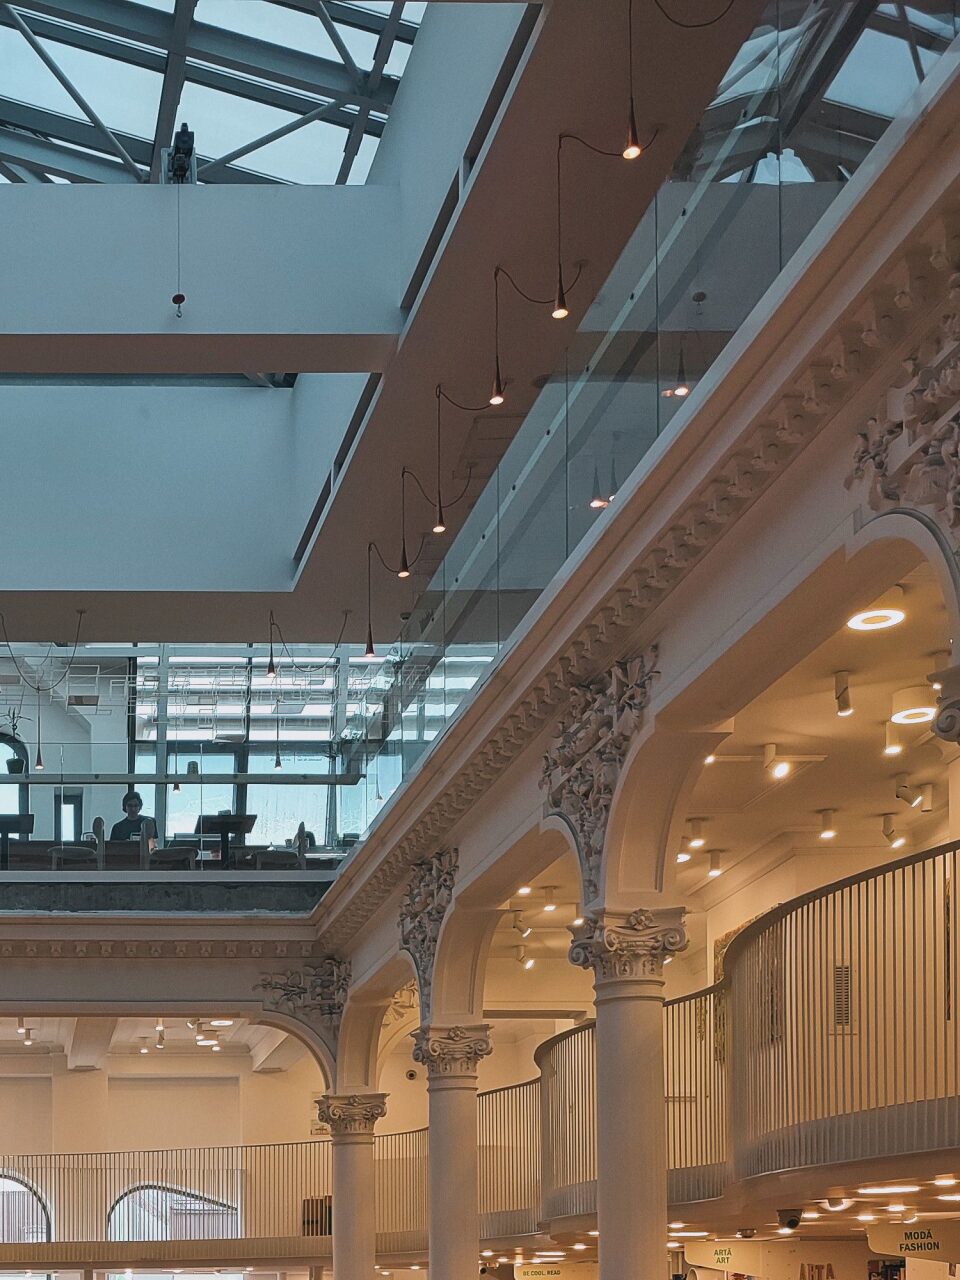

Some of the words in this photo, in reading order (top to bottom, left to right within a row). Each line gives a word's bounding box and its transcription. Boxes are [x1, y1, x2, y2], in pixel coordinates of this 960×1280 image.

[904, 1229, 933, 1241] MODĂ
[899, 1241, 940, 1252] FASHION
[713, 1247, 733, 1257] ARTĂ
[715, 1256, 731, 1264] ART
